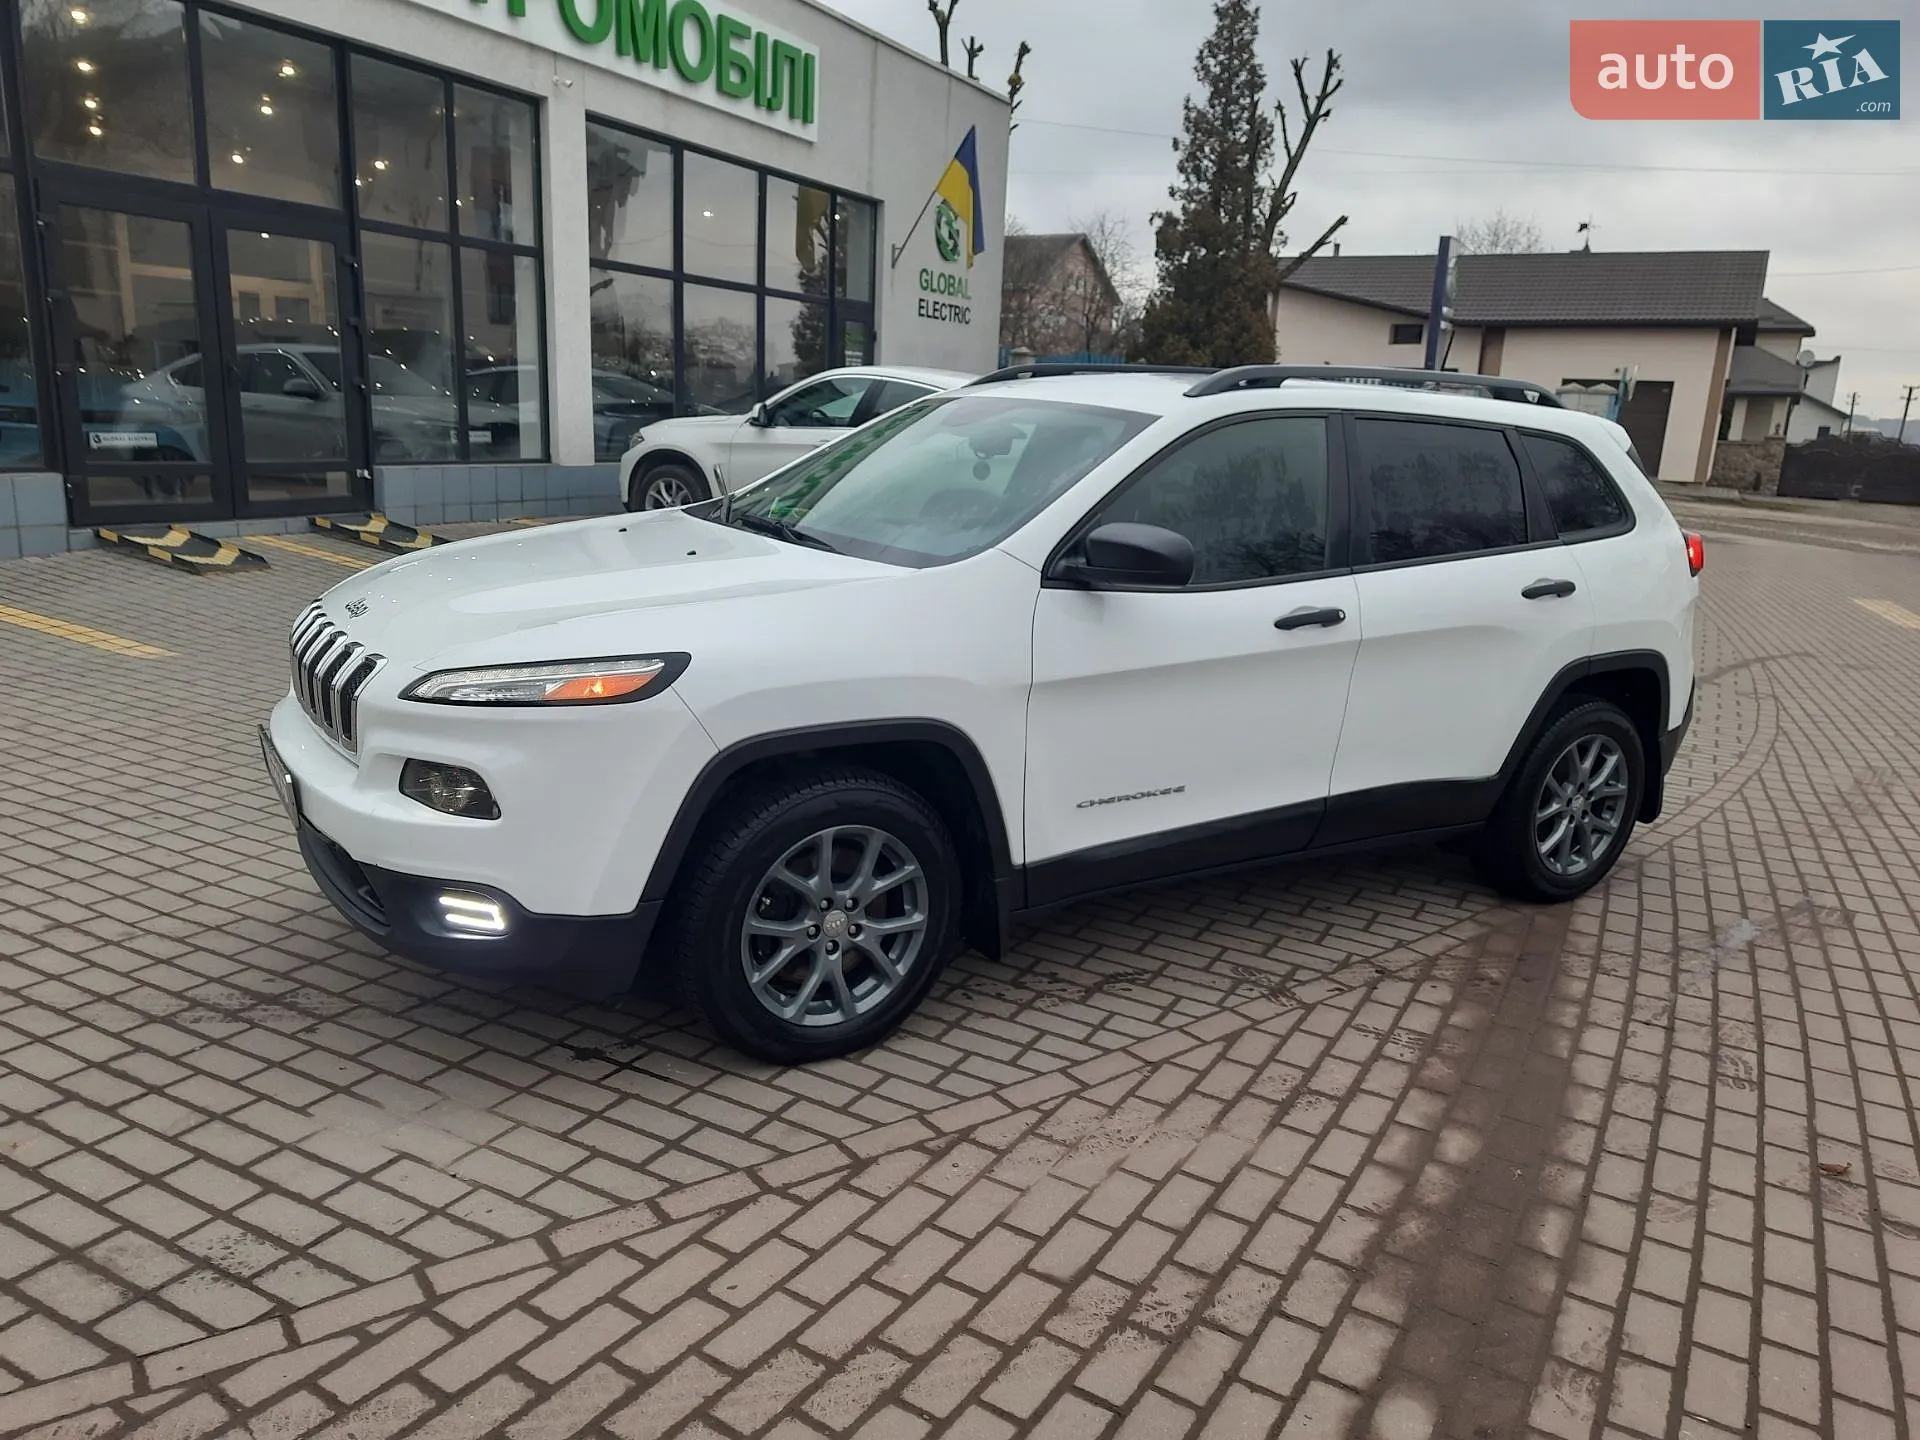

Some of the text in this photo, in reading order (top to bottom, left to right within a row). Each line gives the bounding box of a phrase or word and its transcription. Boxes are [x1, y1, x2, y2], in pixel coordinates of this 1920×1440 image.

[919, 267, 972, 300] GLOBAL
[918, 298, 971, 325] ELECTRIC
[1076, 785, 1186, 808] CHEROKEE
